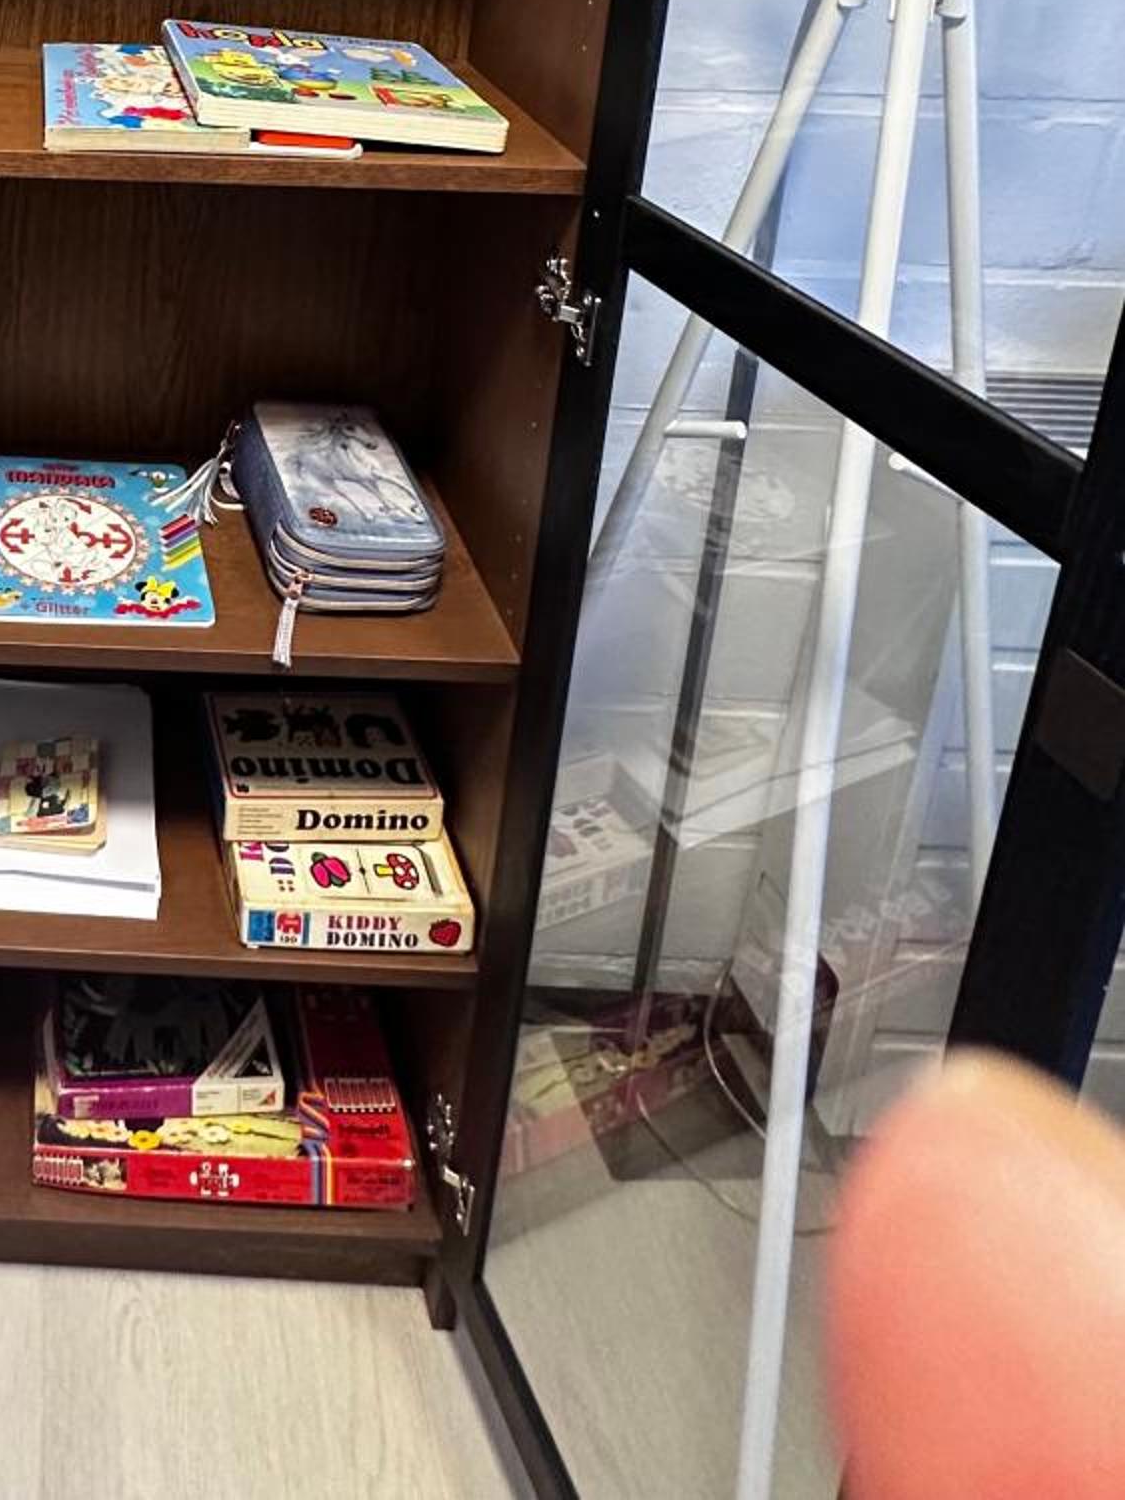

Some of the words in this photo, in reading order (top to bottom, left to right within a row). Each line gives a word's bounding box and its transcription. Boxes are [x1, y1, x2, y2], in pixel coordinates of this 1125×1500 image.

[230, 756, 426, 785] Domino
[295, 809, 430, 832] Domino
[328, 915, 402, 931] KIDDY
[326, 932, 419, 949] DOMINO
